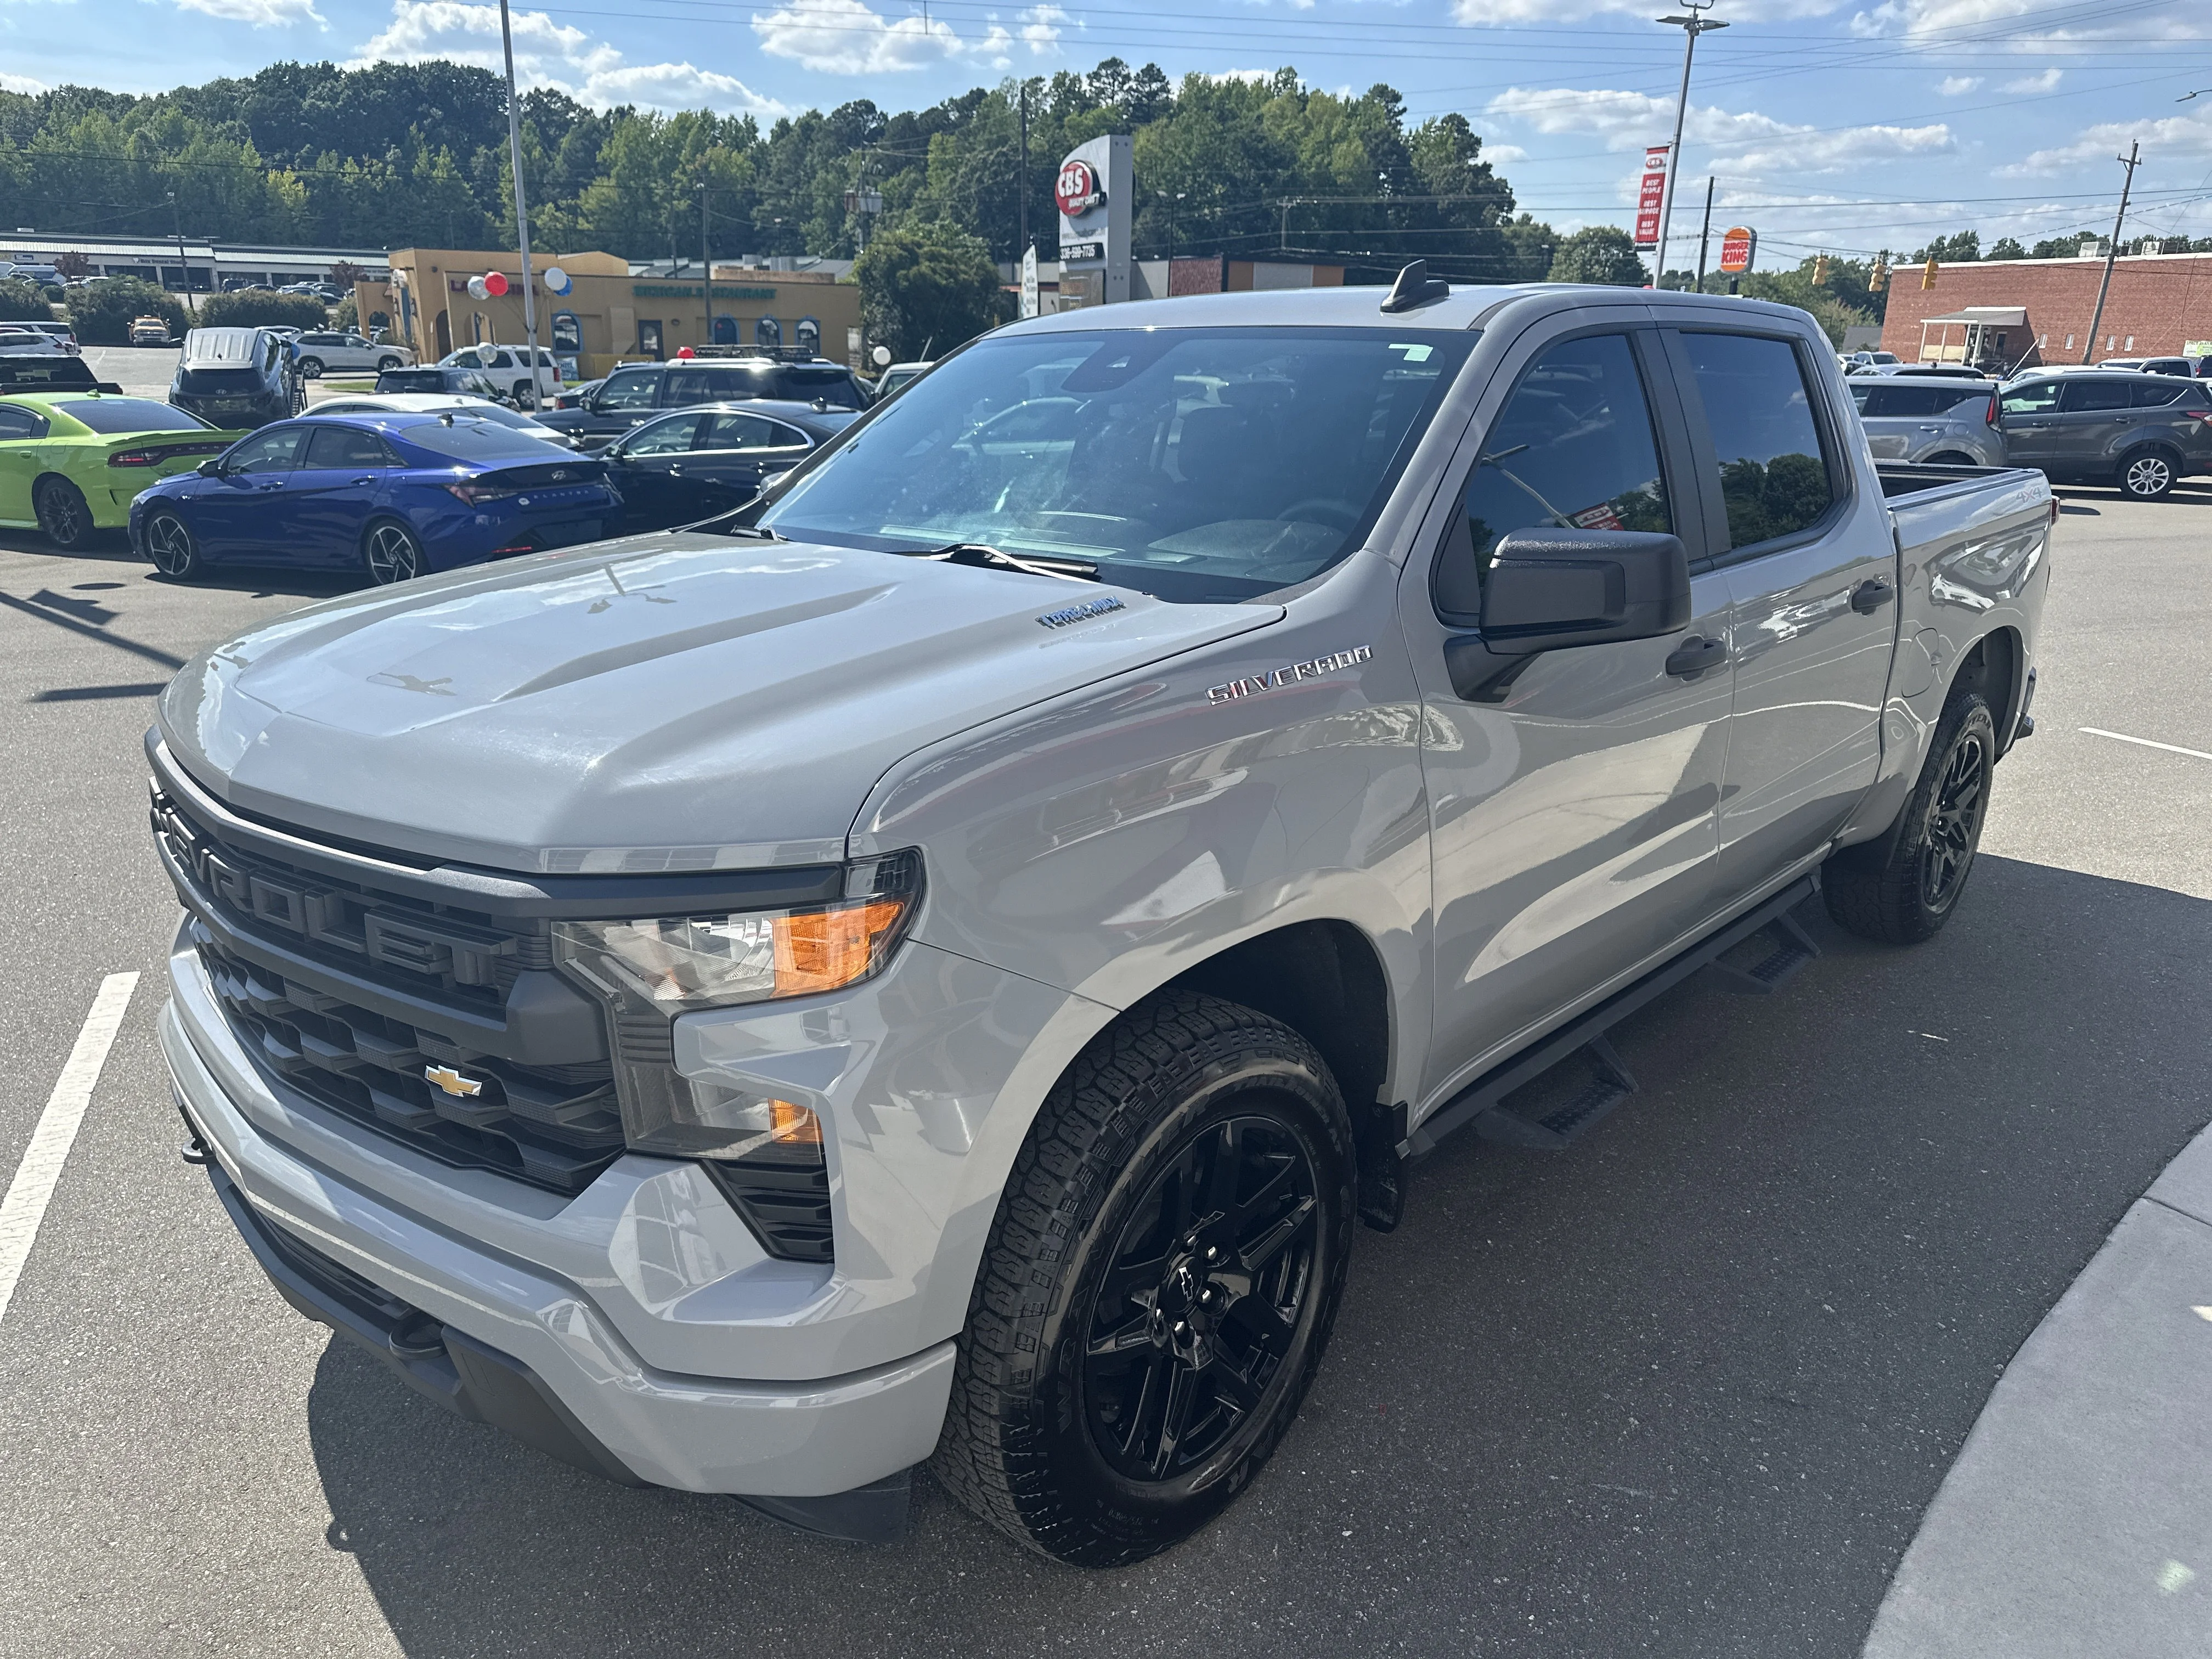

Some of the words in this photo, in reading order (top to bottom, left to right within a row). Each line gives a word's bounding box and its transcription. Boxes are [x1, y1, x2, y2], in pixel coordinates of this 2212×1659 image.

[1058, 167, 1084, 198] CBS
[1642, 187, 1661, 195] PEOPLE
[1724, 241, 1748, 251] BURGER
[1722, 251, 1747, 263] KING
[533, 489, 589, 499] ELANTRA
[1205, 644, 1373, 706] SILVERADO
